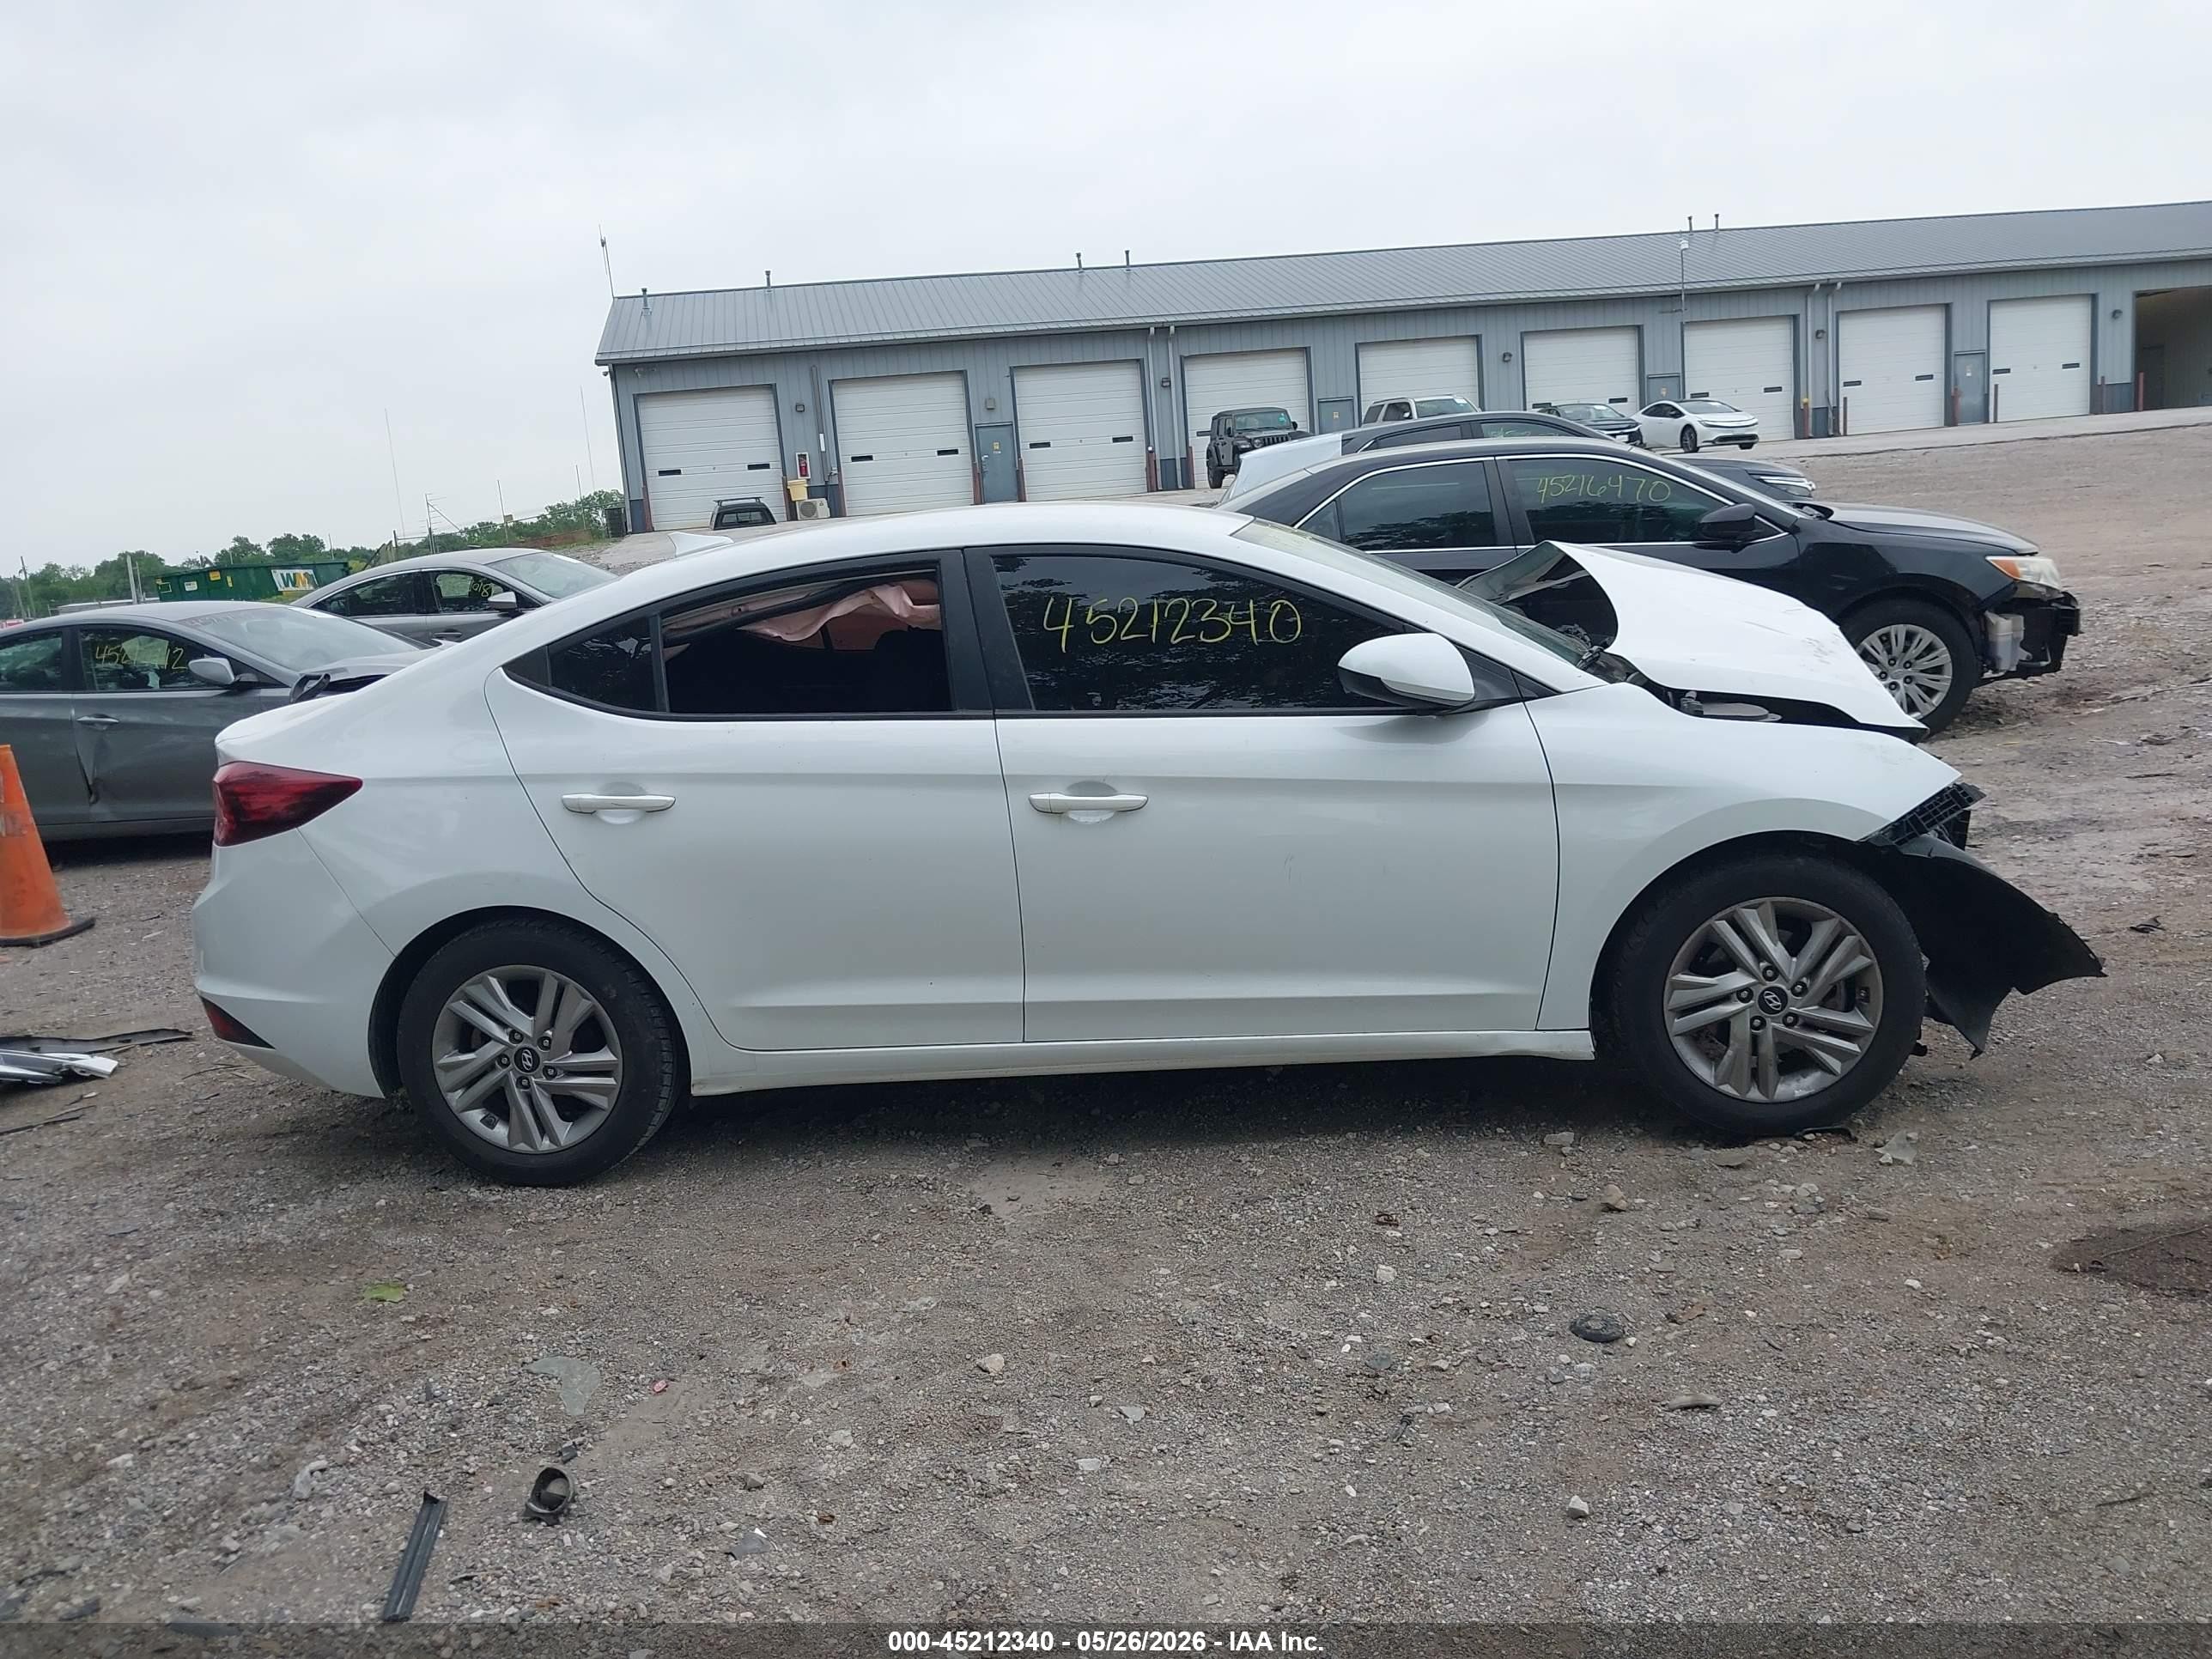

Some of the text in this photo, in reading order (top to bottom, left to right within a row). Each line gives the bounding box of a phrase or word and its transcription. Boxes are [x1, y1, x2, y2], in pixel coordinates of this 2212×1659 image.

[1537, 475, 1671, 503] 45216470
[280, 572, 310, 588] WM
[1042, 597, 1303, 653] 45212340
